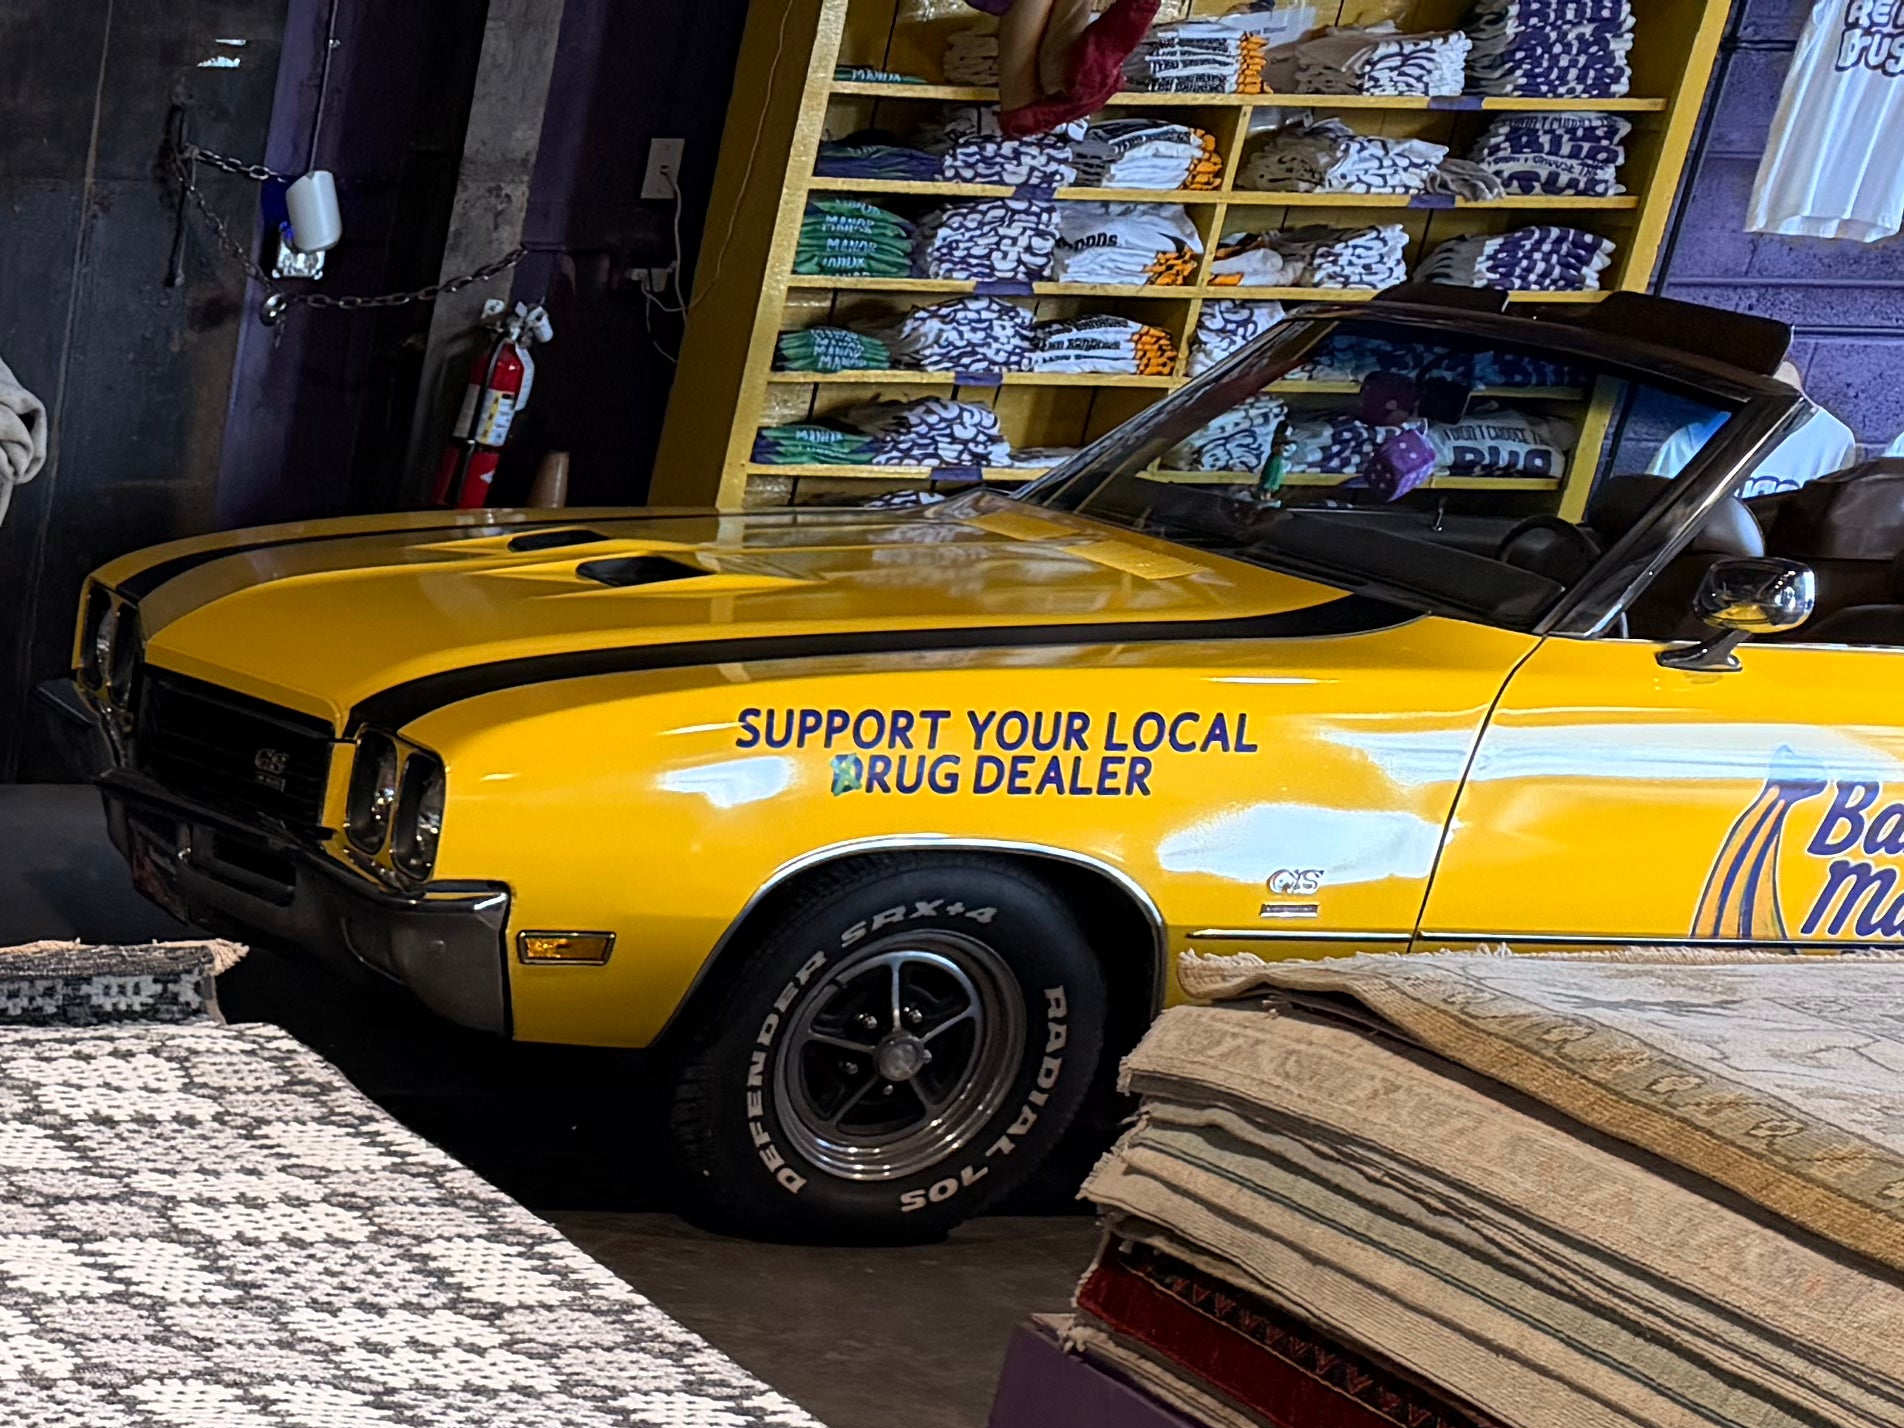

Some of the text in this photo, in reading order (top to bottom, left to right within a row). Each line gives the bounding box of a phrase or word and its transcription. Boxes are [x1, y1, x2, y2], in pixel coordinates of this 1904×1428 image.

[735, 708, 1259, 753] SUPPORT YOUR LOCAL
[973, 755, 1153, 796] DEALER
[746, 899, 998, 1195] DEFENDER SRX+4
[985, 984, 1069, 1159] RADIAL
